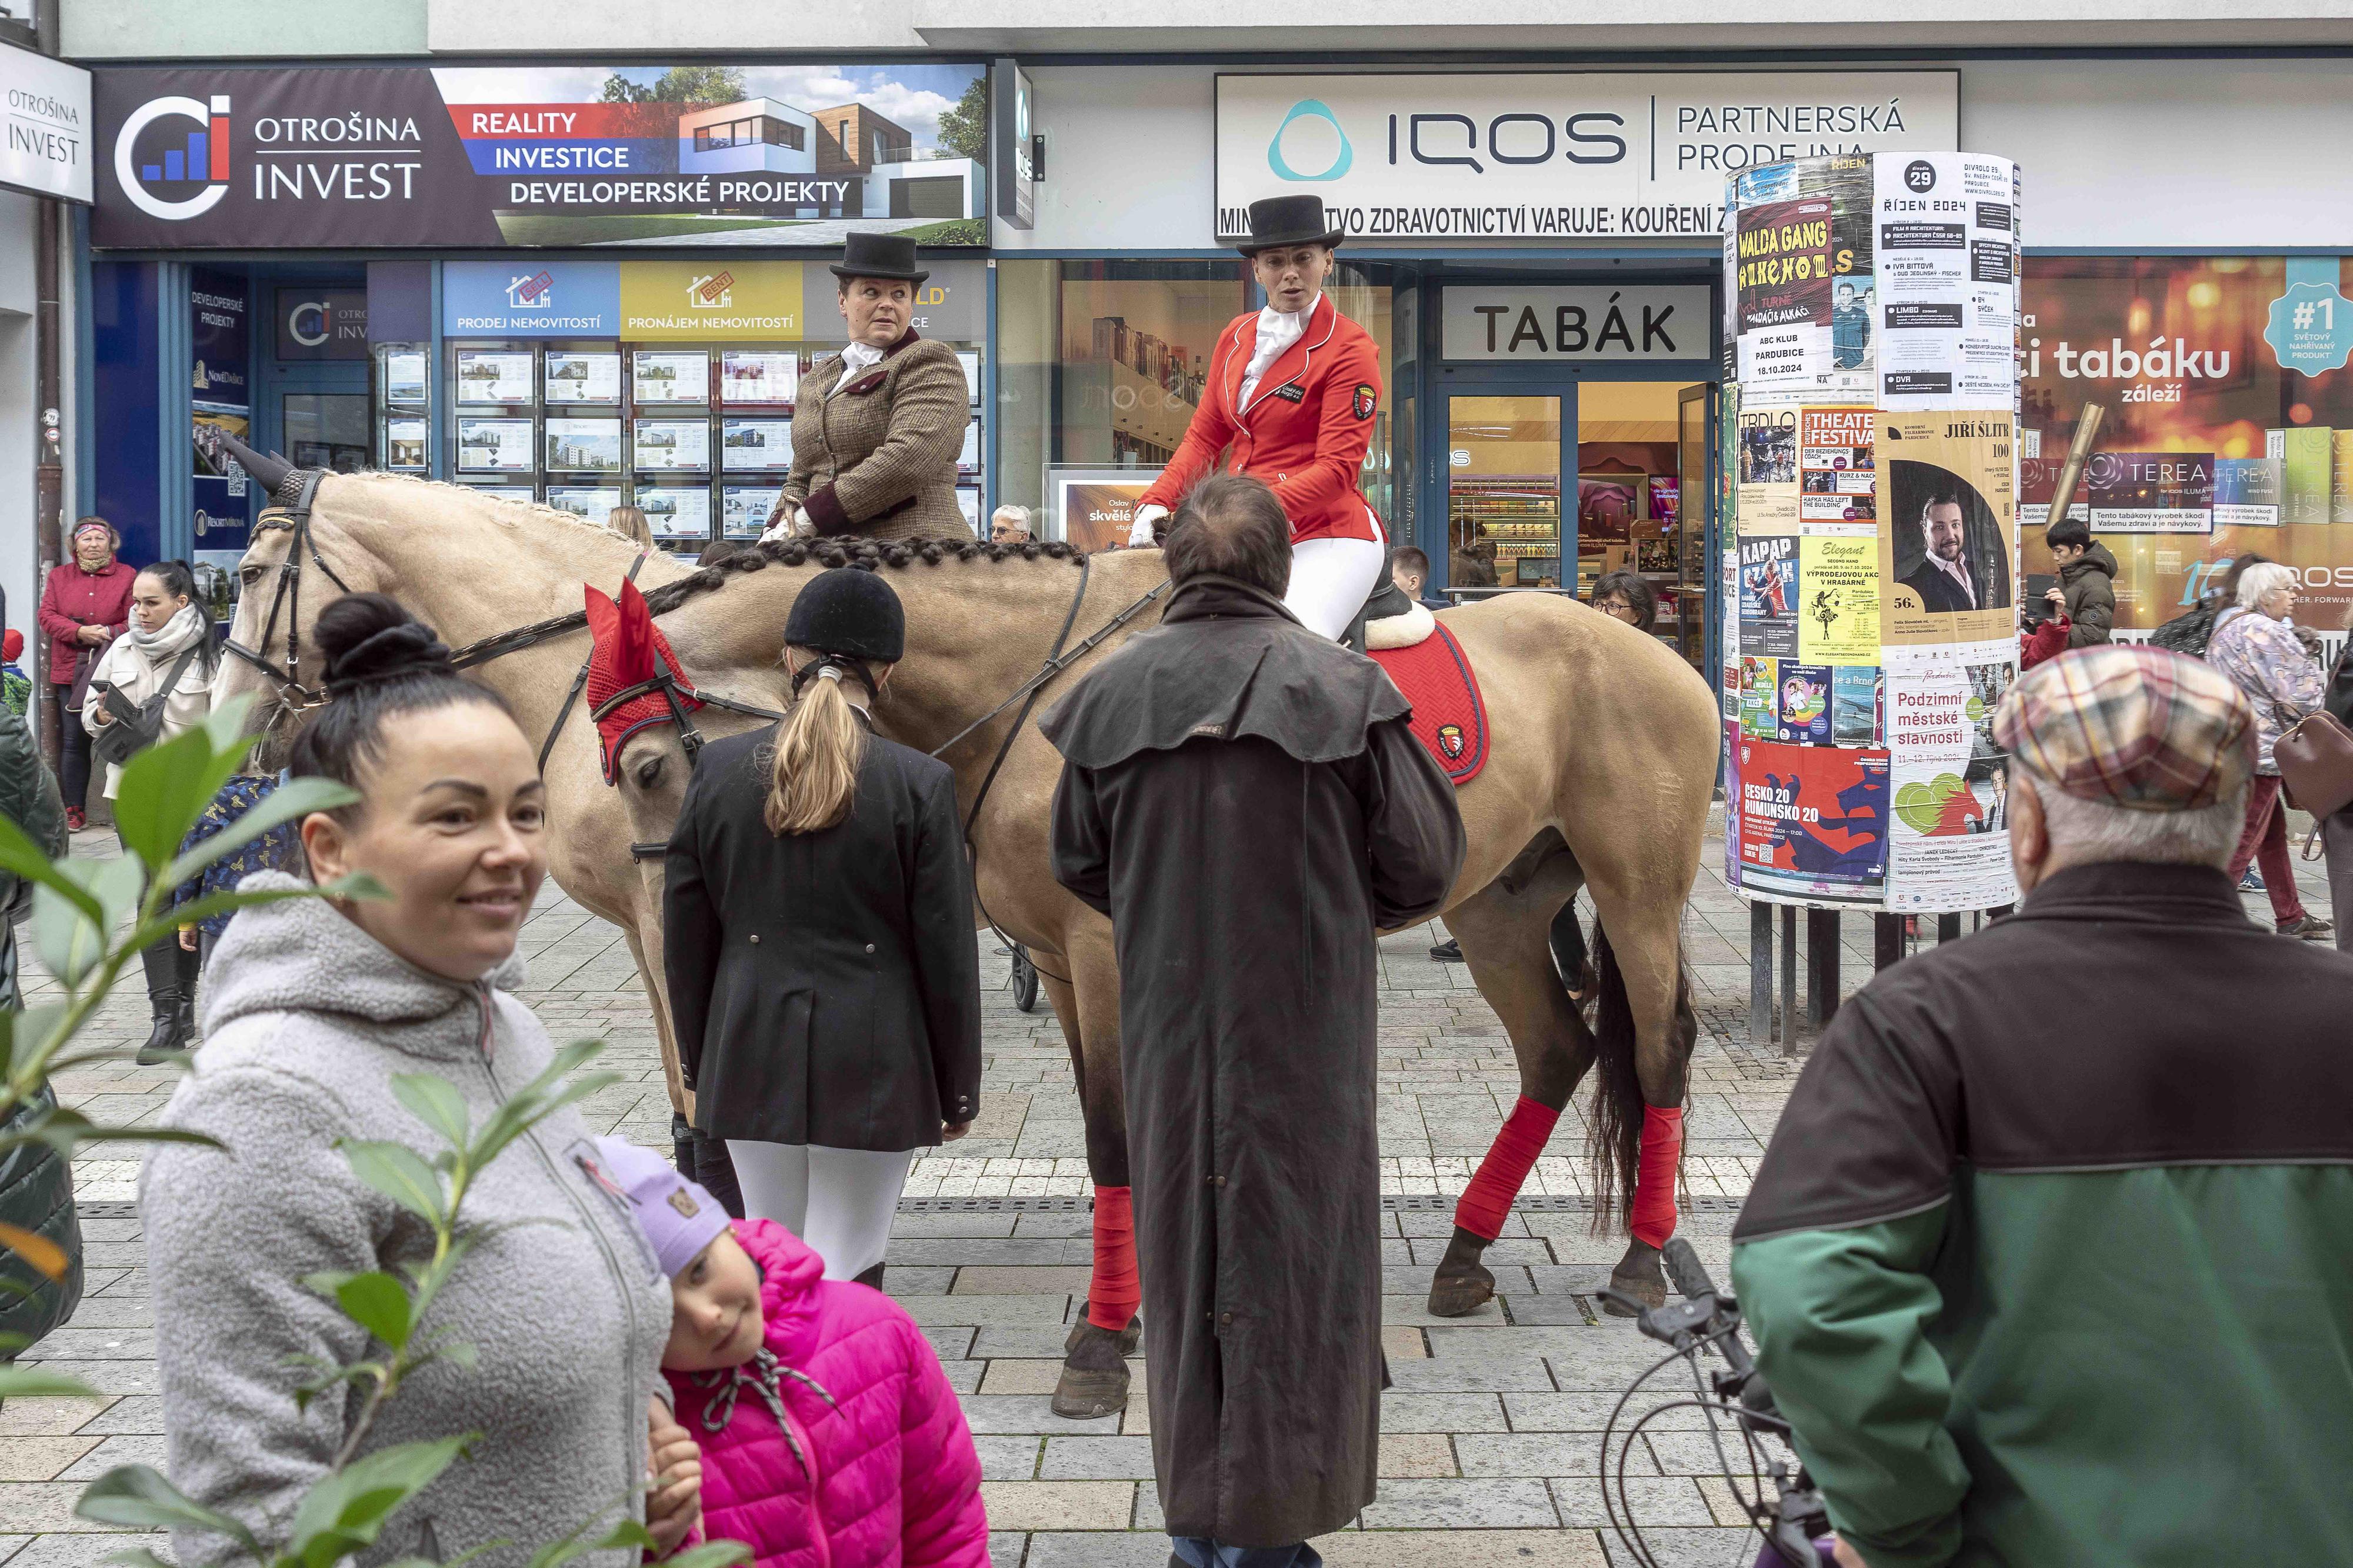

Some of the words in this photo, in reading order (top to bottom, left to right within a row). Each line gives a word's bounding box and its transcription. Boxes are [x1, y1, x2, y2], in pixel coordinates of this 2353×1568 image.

[9, 89, 78, 125] OTROŠINA
[1678, 98, 1905, 133] PARTNERSKÁ
[255, 111, 421, 142] OTROŠINA
[472, 113, 576, 134] REALITY
[9, 123, 79, 165] INVEST
[1389, 113, 1627, 174] IQOS
[495, 147, 629, 169] INVESTICE
[255, 163, 421, 201] INVEST
[1911, 172, 1931, 186] 29
[511, 175, 711, 203] DEVELOPERSKÉ
[719, 181, 849, 203] PROJEKTY
[1884, 199, 1926, 211] ŘÍJEN
[1934, 201, 1966, 212] 2024
[1371, 202, 1526, 234] ZDRAVOTNICTVÍ
[1532, 207, 1615, 233] VARUJE:
[1622, 202, 1712, 233] KOUŘENÍ
[1739, 228, 1778, 259] WALDA
[1781, 221, 1827, 251] GANG
[524, 276, 548, 298] SELL
[704, 275, 730, 297] RENT
[192, 292, 244, 312] DEVELOPERSKÉ
[201, 312, 234, 328] PROJEKTY
[458, 318, 506, 328] PRODEJ
[511, 315, 601, 328] NEMOVITOSTÍ
[628, 315, 698, 328] PRONÁJEM
[703, 315, 793, 328] NEMOVITOSTÍ
[1474, 291, 1677, 353] TABÁK
[2293, 298, 2333, 329] #1
[1760, 336, 1774, 345] ABC
[1777, 335, 1798, 343] KLUB
[2294, 332, 2330, 341] SVĚTOVÝ
[1756, 348, 1804, 360] PARDUBICE
[2289, 341, 2335, 350] NAHŘÍVANÝ
[2054, 335, 2229, 379] tabáku
[1757, 363, 1802, 375] 18.10.2024
[2122, 383, 2182, 402] záleží
[1944, 421, 1975, 438] JIŘÍ
[1978, 421, 2009, 438] ŠLITR
[1992, 443, 2009, 458] 100
[2129, 463, 2207, 481] TEREA
[2214, 468, 2274, 482] TEREA
[2334, 463, 2348, 517] TEREA
[1089, 509, 1131, 522] skvělé
[2119, 512, 2151, 521] tabákový
[2168, 519, 2203, 528] návykový.
[1742, 538, 1791, 565] KAPAP
[1822, 542, 1865, 558] Elegant
[1894, 598, 1915, 609] 56.
[1854, 676, 1873, 685] Brno
[1898, 691, 1962, 706] Podzimní
[1898, 710, 1958, 726] městské
[1898, 730, 1962, 745] slavnosti
[1745, 782, 1773, 802] ČESKO
[1775, 788, 1790, 804] 20
[1745, 800, 1799, 821] RUMUNSKO
[1802, 808, 1819, 823] 20
[1745, 822, 1758, 830] ČTVRTEK
